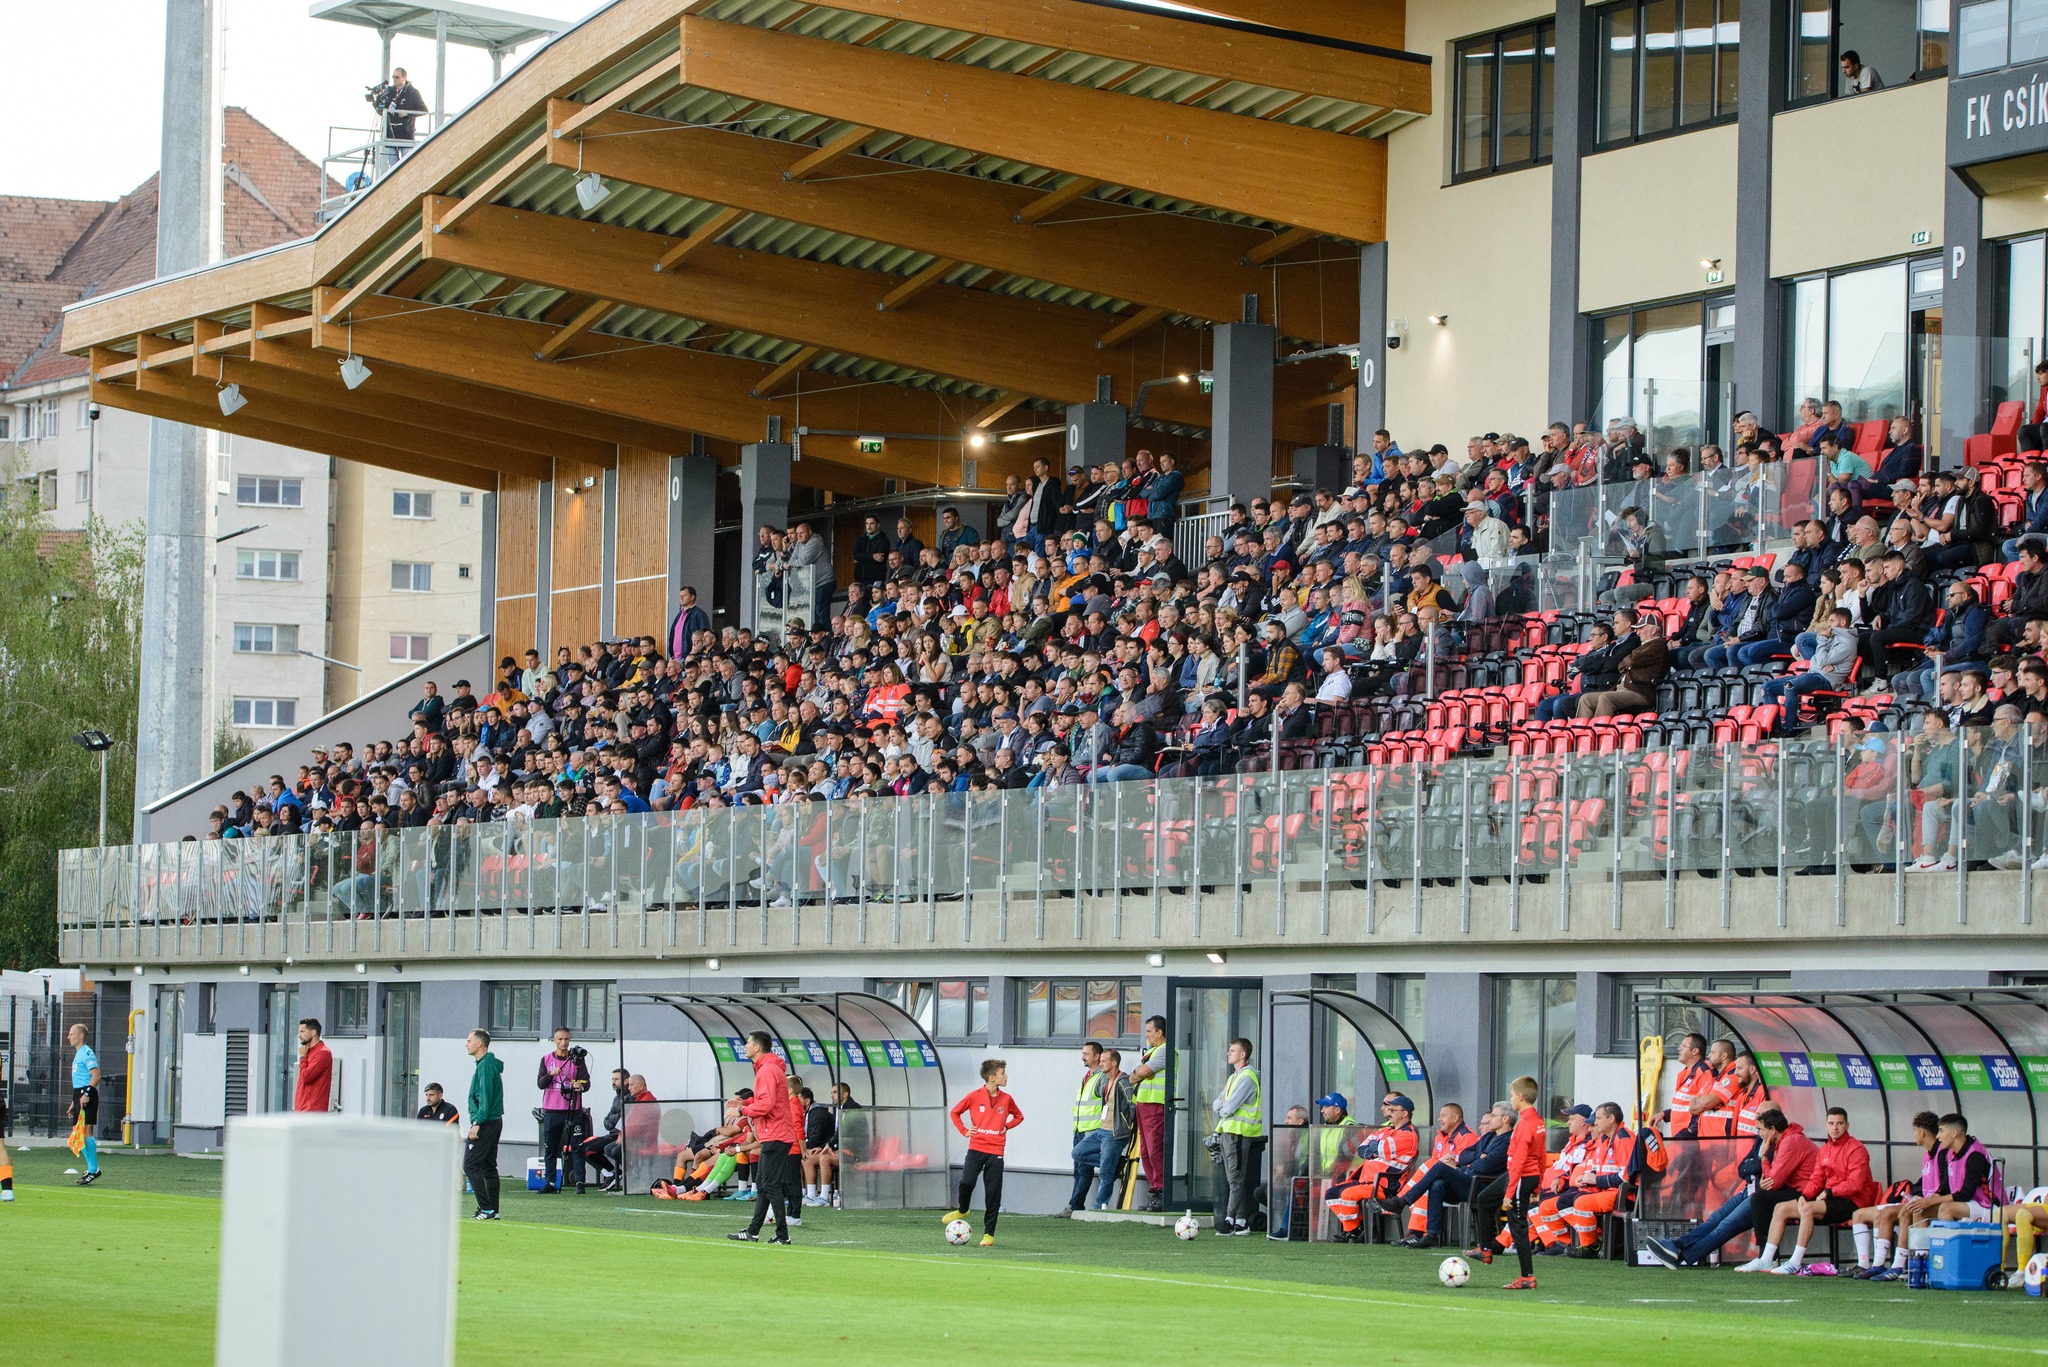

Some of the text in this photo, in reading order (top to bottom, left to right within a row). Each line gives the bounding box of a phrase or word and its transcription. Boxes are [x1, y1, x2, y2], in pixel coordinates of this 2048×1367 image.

[1967, 73, 2048, 140] FK CSÍK
[1952, 245, 1966, 280] P
[1846, 1065, 1873, 1078] YOUTH
[1916, 1066, 1945, 1078] YOUTH
[1991, 1067, 2019, 1079] YOUTH
[1853, 1077, 1872, 1085] LEAGUE
[1924, 1078, 1944, 1086] LEAGUE
[1999, 1079, 2019, 1087] LEAGUE
